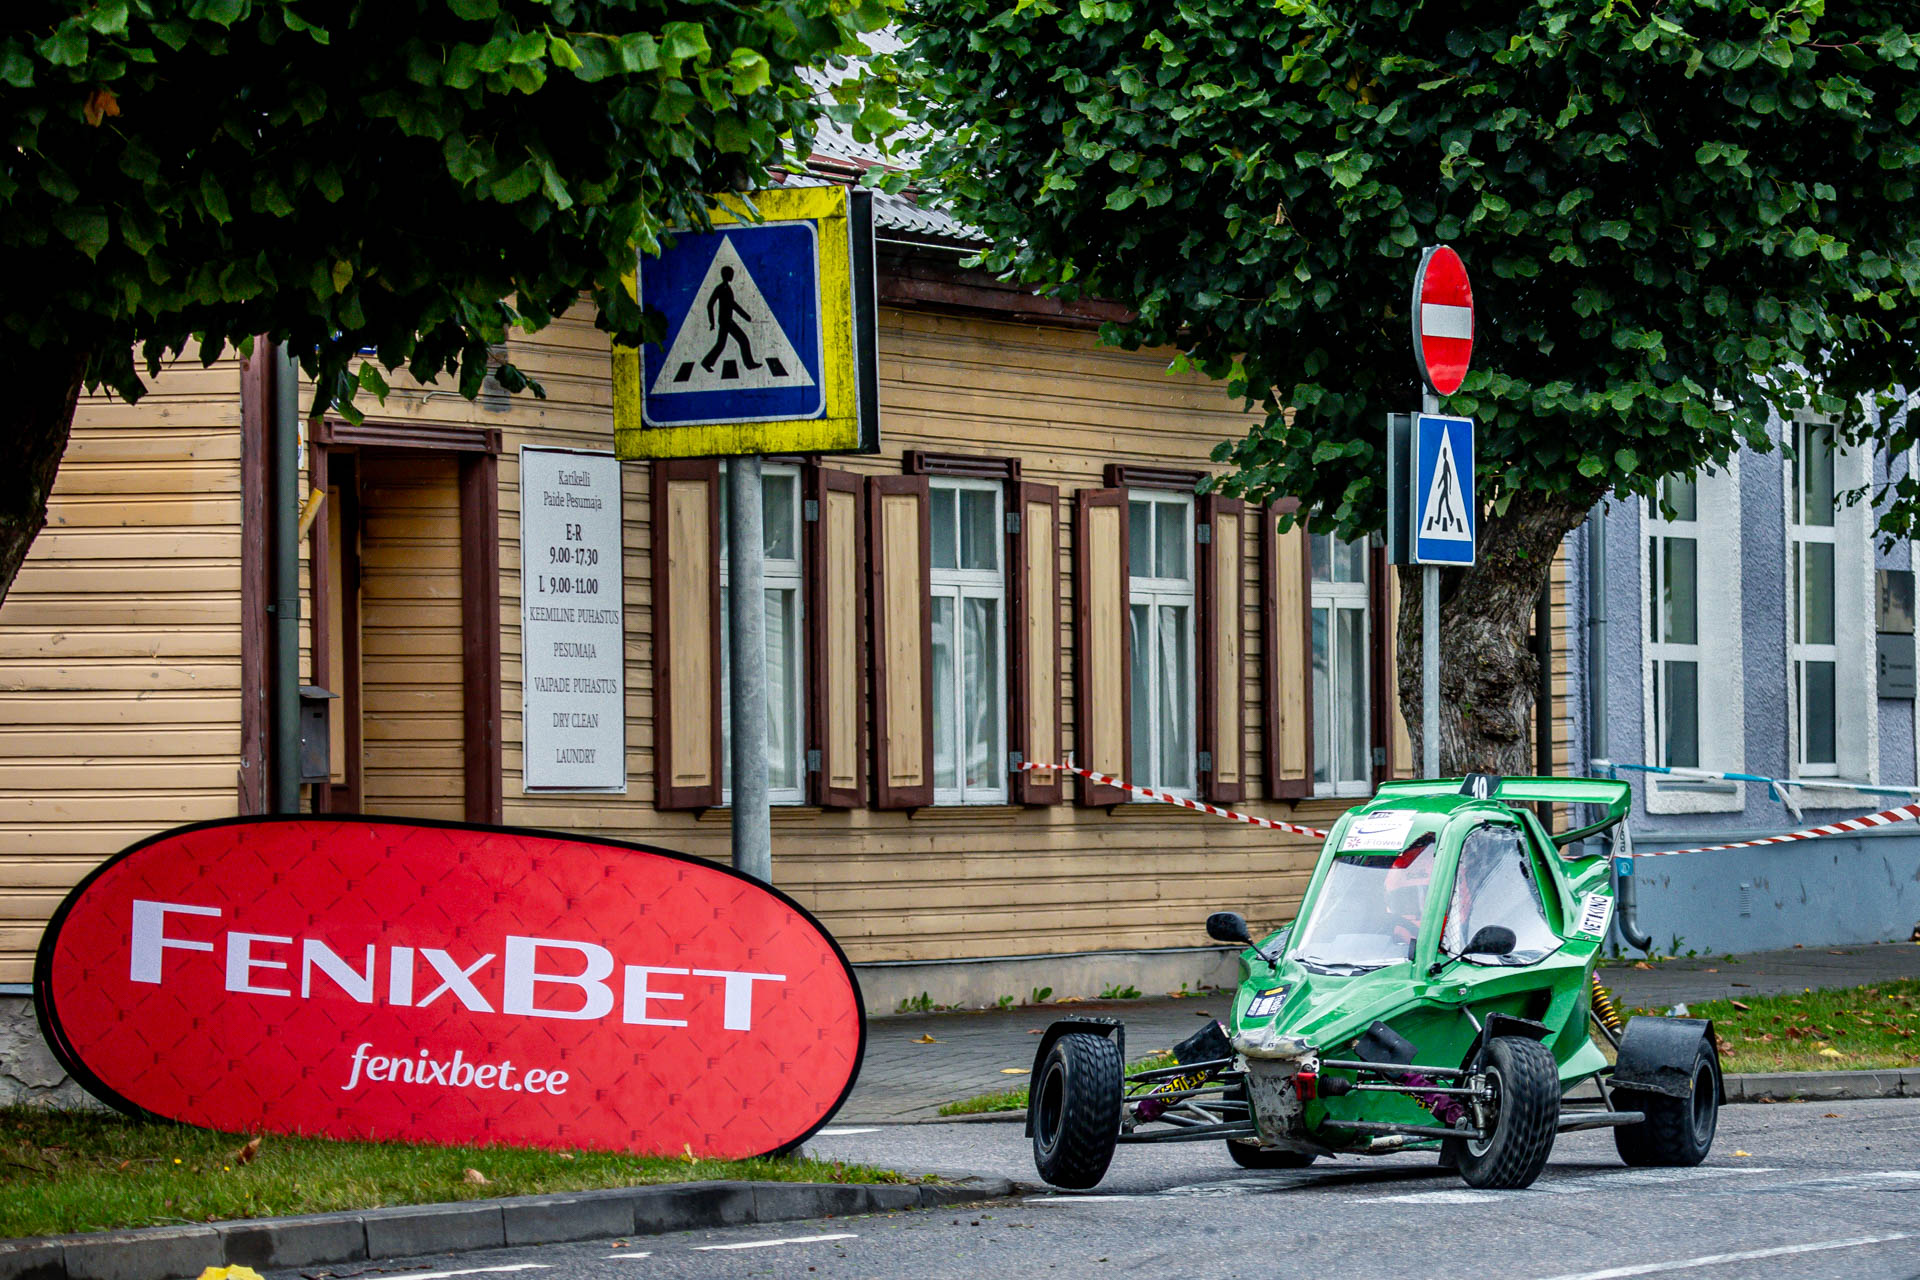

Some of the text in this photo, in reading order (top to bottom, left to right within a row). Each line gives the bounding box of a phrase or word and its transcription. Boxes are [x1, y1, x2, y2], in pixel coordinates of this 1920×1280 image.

[543, 491, 602, 512] Paide Pesumaja
[566, 523, 583, 542] E-R
[550, 546, 598, 566] 9.00-17.30
[539, 575, 598, 595] L 9.00-11.00
[529, 606, 619, 625] KEEMILINE PUHASTUS
[553, 642, 597, 659] PESUMAJA
[534, 677, 617, 694] VAIPADE PUHASTUS
[553, 712, 599, 728] DRY CLEAN
[556, 748, 596, 764] LAUNDRY
[341, 1042, 569, 1095] fenixbet.ee
